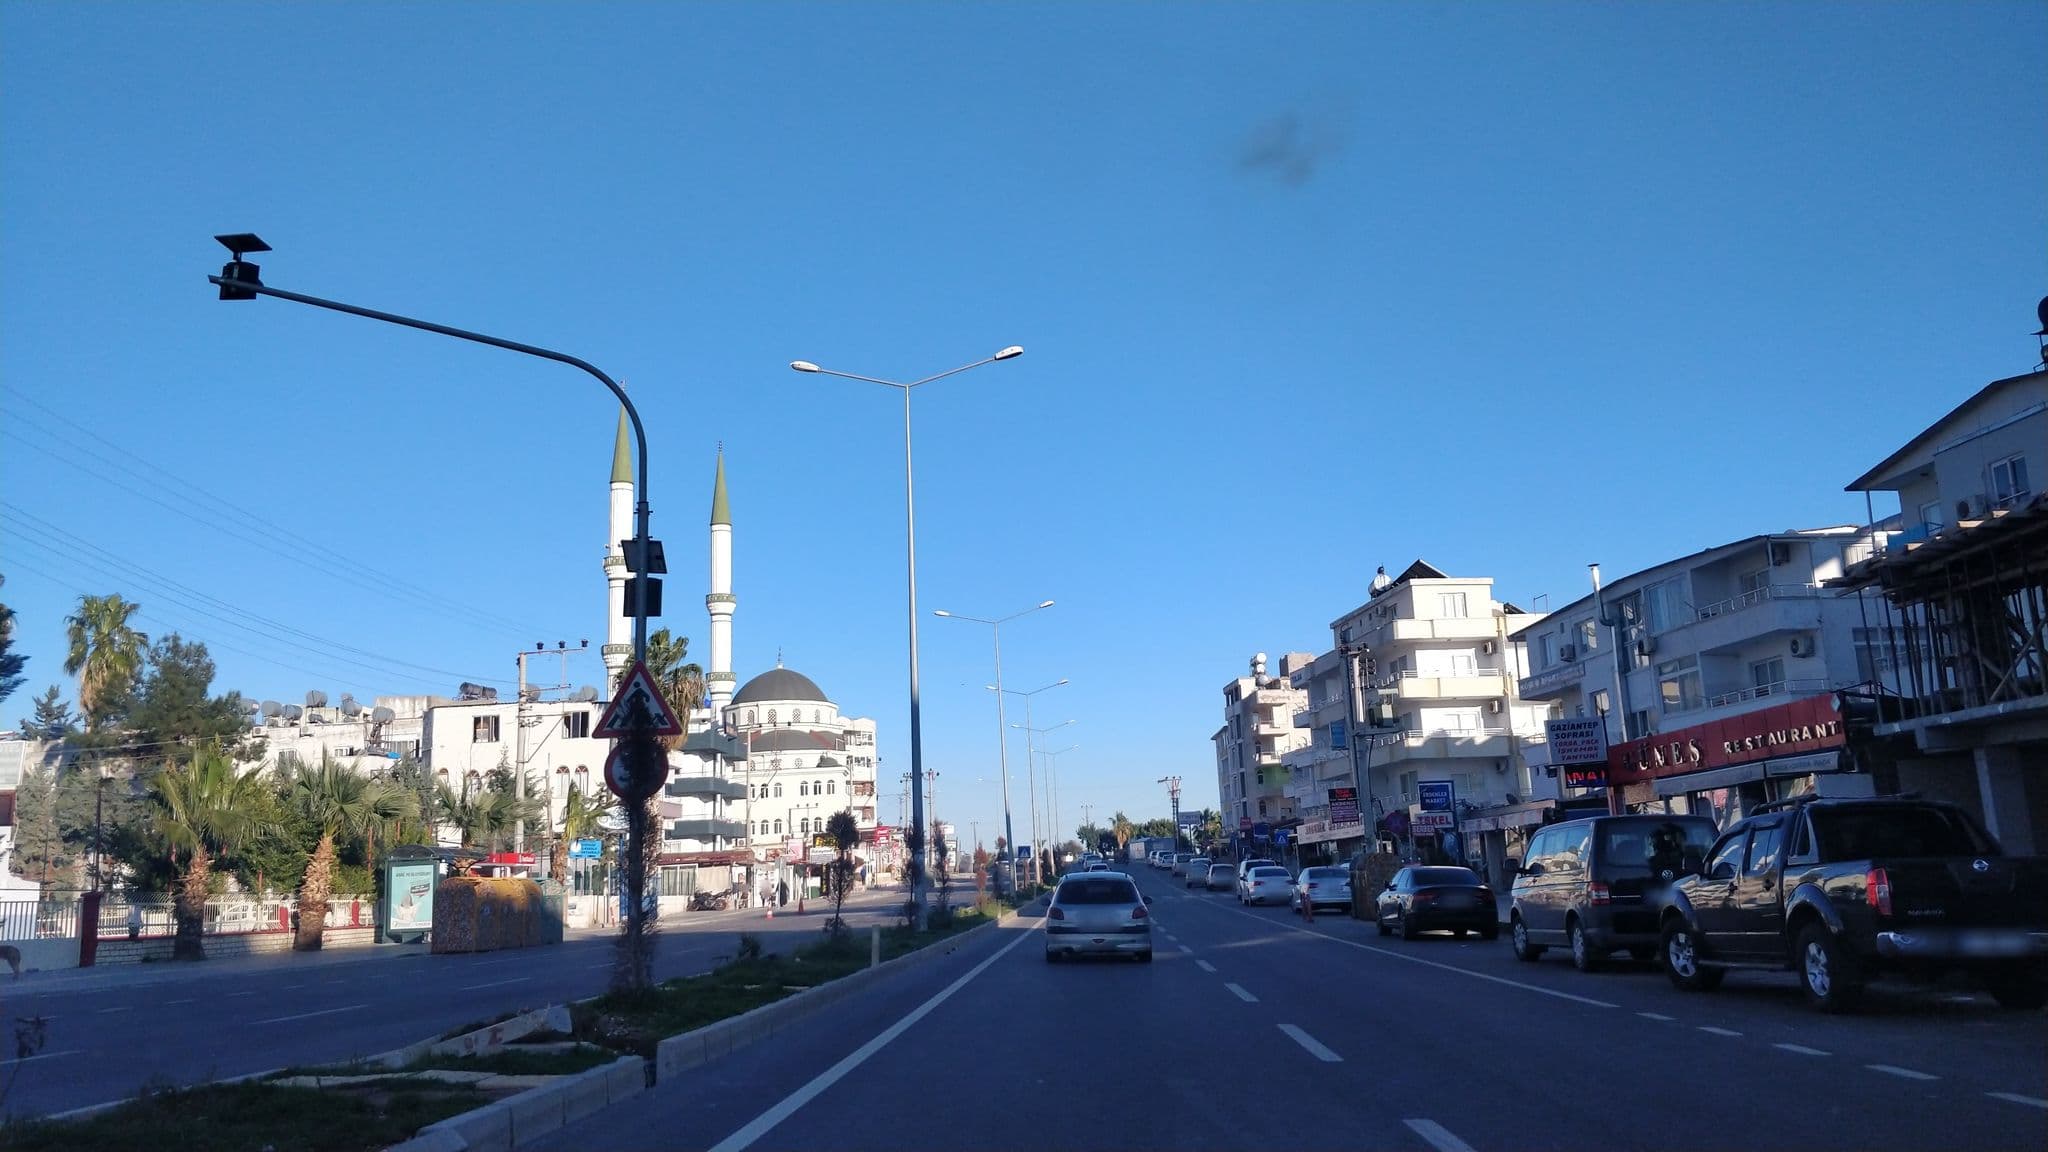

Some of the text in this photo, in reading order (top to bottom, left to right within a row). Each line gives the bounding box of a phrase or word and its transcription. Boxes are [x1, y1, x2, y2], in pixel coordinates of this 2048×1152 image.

[1555, 730, 1594, 740] SOFRASI
[1723, 720, 1837, 754] RESTAURANT
[1417, 815, 1452, 825] TEKEL
